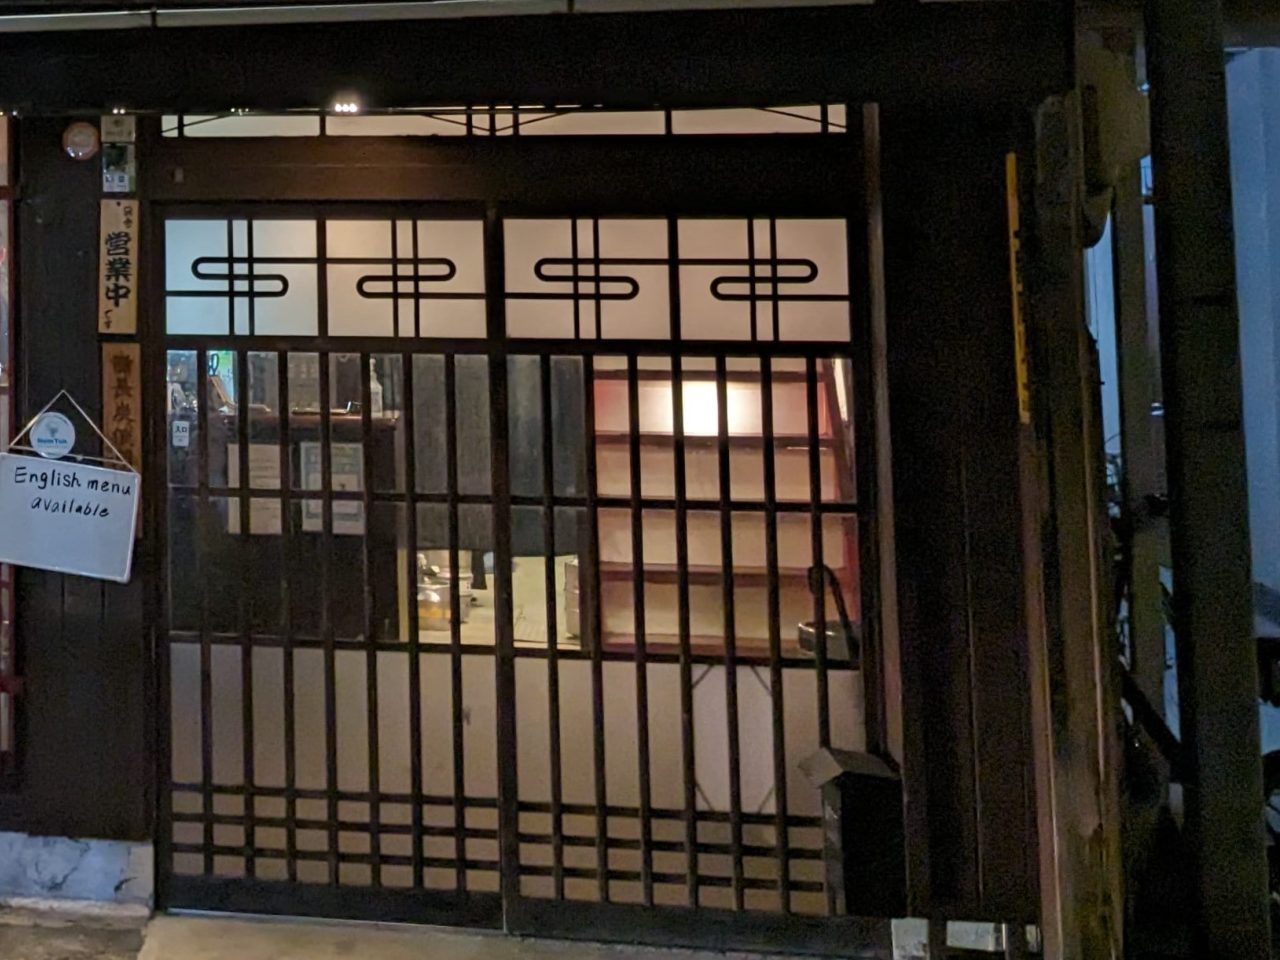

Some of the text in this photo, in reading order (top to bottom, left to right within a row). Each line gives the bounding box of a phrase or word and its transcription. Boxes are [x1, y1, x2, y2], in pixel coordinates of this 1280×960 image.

[105, 231, 132, 308] 営業中
[14, 466, 131, 496] English menu
[31, 497, 110, 517] available
